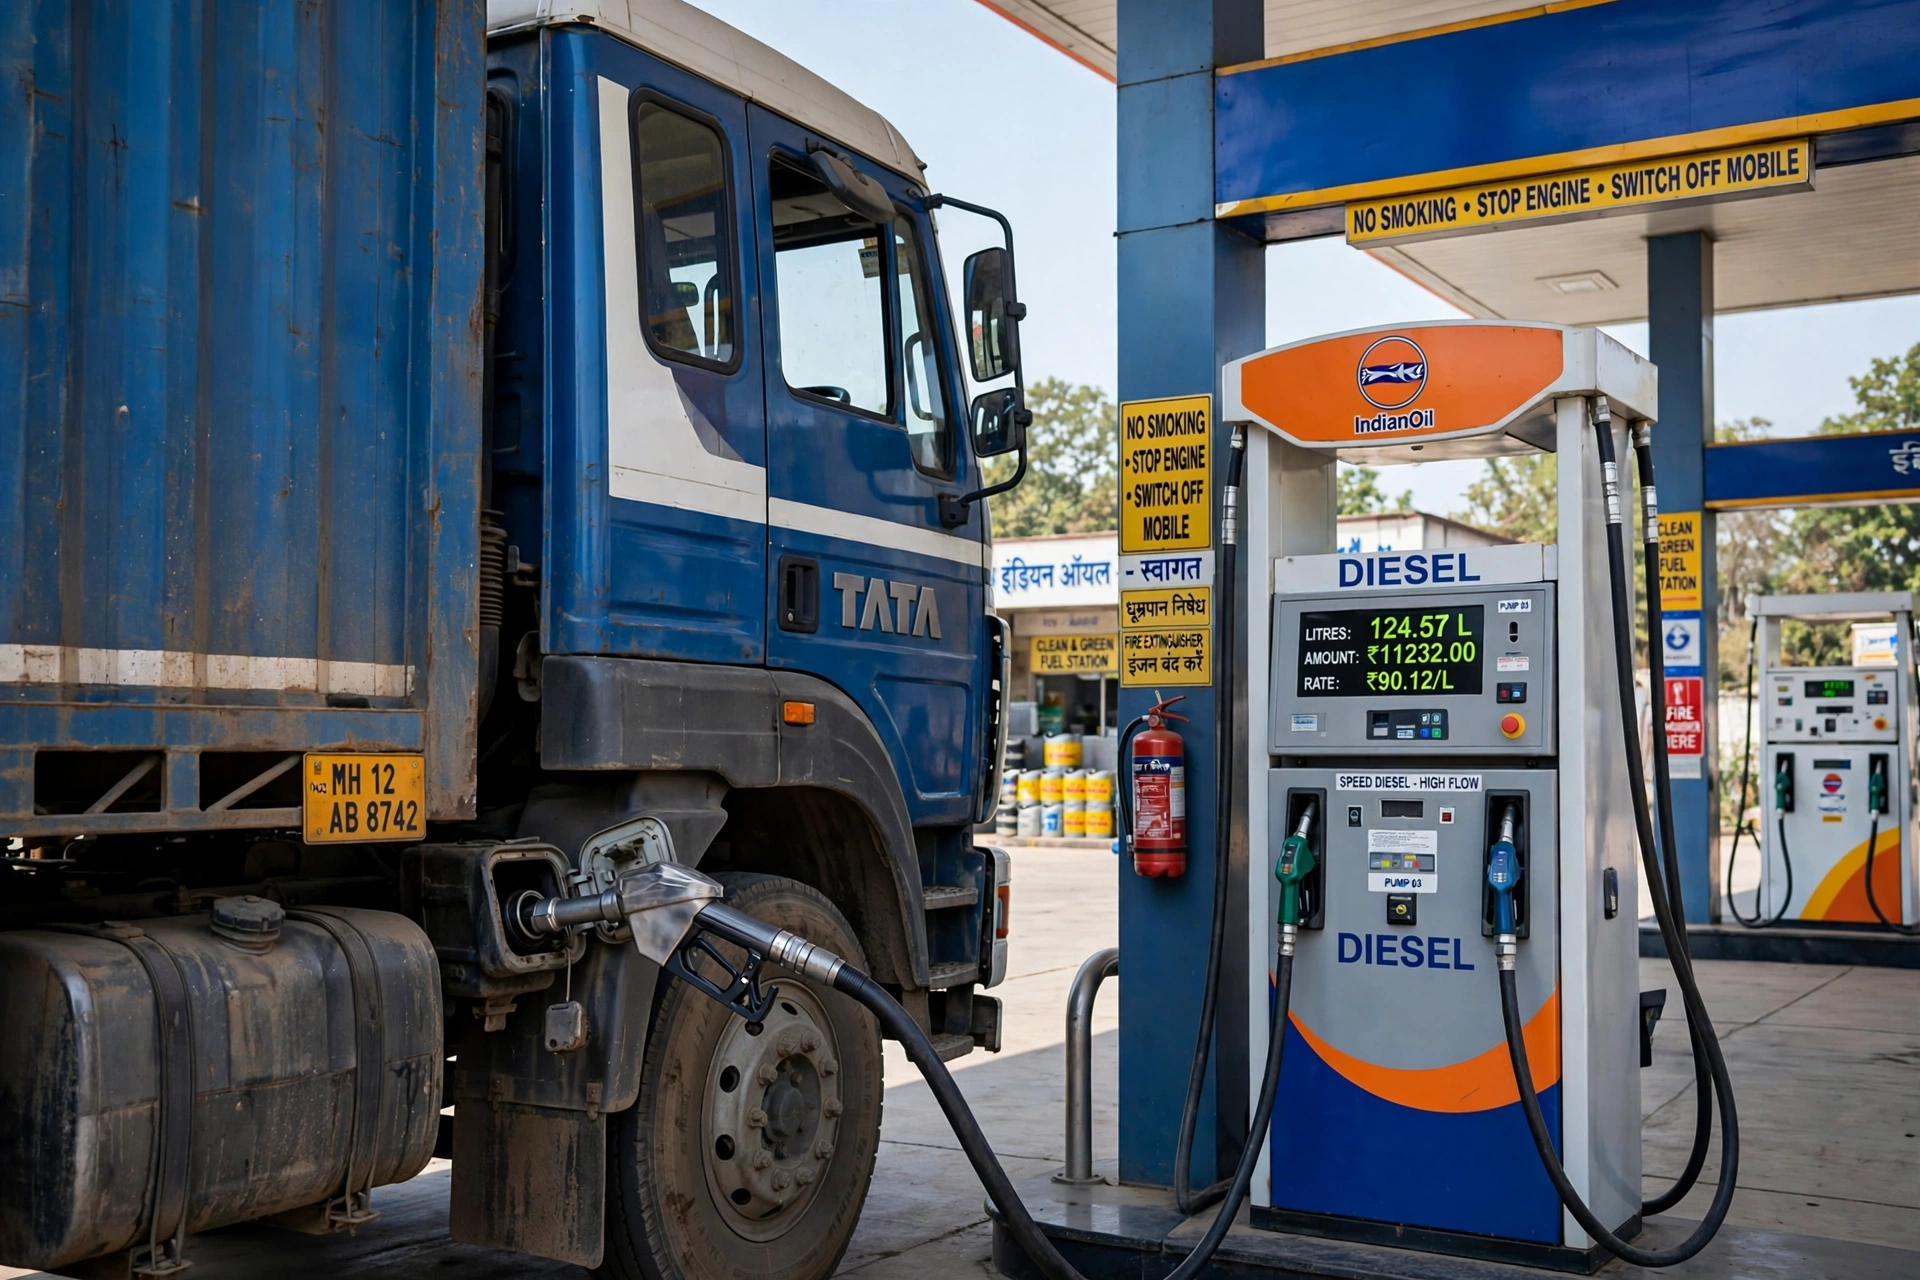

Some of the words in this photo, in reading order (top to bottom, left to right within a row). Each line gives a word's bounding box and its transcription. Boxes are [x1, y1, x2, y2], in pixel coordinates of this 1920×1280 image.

[1354, 207, 1376, 234] NO
[1381, 196, 1456, 230] SMOKING
[1477, 187, 1521, 218] STOP
[1526, 178, 1590, 211] ENGINE
[1611, 165, 1680, 199] SWITCH
[1686, 159, 1721, 189] OFF
[1727, 148, 1799, 184] MOBILE
[1127, 415, 1144, 440] NO
[1147, 410, 1205, 439] SMOKING
[1355, 409, 1433, 433] IndianOil
[1132, 448, 1161, 474] STOP
[1164, 444, 1205, 472] ENGINE
[1134, 481, 1178, 508] SWITCH
[1181, 480, 1204, 505] OFF
[1143, 514, 1190, 541] MOBILE
[1658, 520, 1693, 536] CLEAN
[1659, 538, 1694, 554] GREEN
[1001, 557, 1054, 594] इंडियन
[1060, 554, 1110, 587] ऑयल
[1140, 557, 1202, 582] स्वागत
[1339, 553, 1481, 588] DIESEL
[1660, 557, 1686, 572] FUEL
[1660, 575, 1696, 590] TATION
[833, 571, 942, 639] TATA
[1172, 593, 1206, 616] निषेध
[1305, 627, 1352, 641] LITRES:
[1371, 614, 1449, 639] 124.57
[1458, 613, 1472, 637] L
[1036, 639, 1068, 653] CLEAN
[1080, 637, 1114, 651] GREEN
[1304, 651, 1359, 665] AMOUNT:
[1367, 641, 1476, 664] ₹11232.00
[1041, 655, 1063, 669] FUEL
[1067, 655, 1109, 669] STATION
[1127, 652, 1158, 677] इंजन
[1304, 676, 1340, 690] RATE:
[1366, 669, 1454, 691] ₹90.12/L
[1666, 705, 1695, 720] FIRE
[332, 763, 361, 795] MH
[371, 763, 395, 795] 12
[1340, 776, 1372, 788] SPEED
[1375, 776, 1410, 788] DIESEL
[1420, 777, 1445, 789] HIGH
[1449, 777, 1479, 789] FLOW
[329, 801, 359, 834] AB
[366, 800, 418, 833] 8742
[1384, 878, 1410, 888] PUMP
[1411, 879, 1422, 888] 03
[1338, 932, 1475, 970] DIESEL
